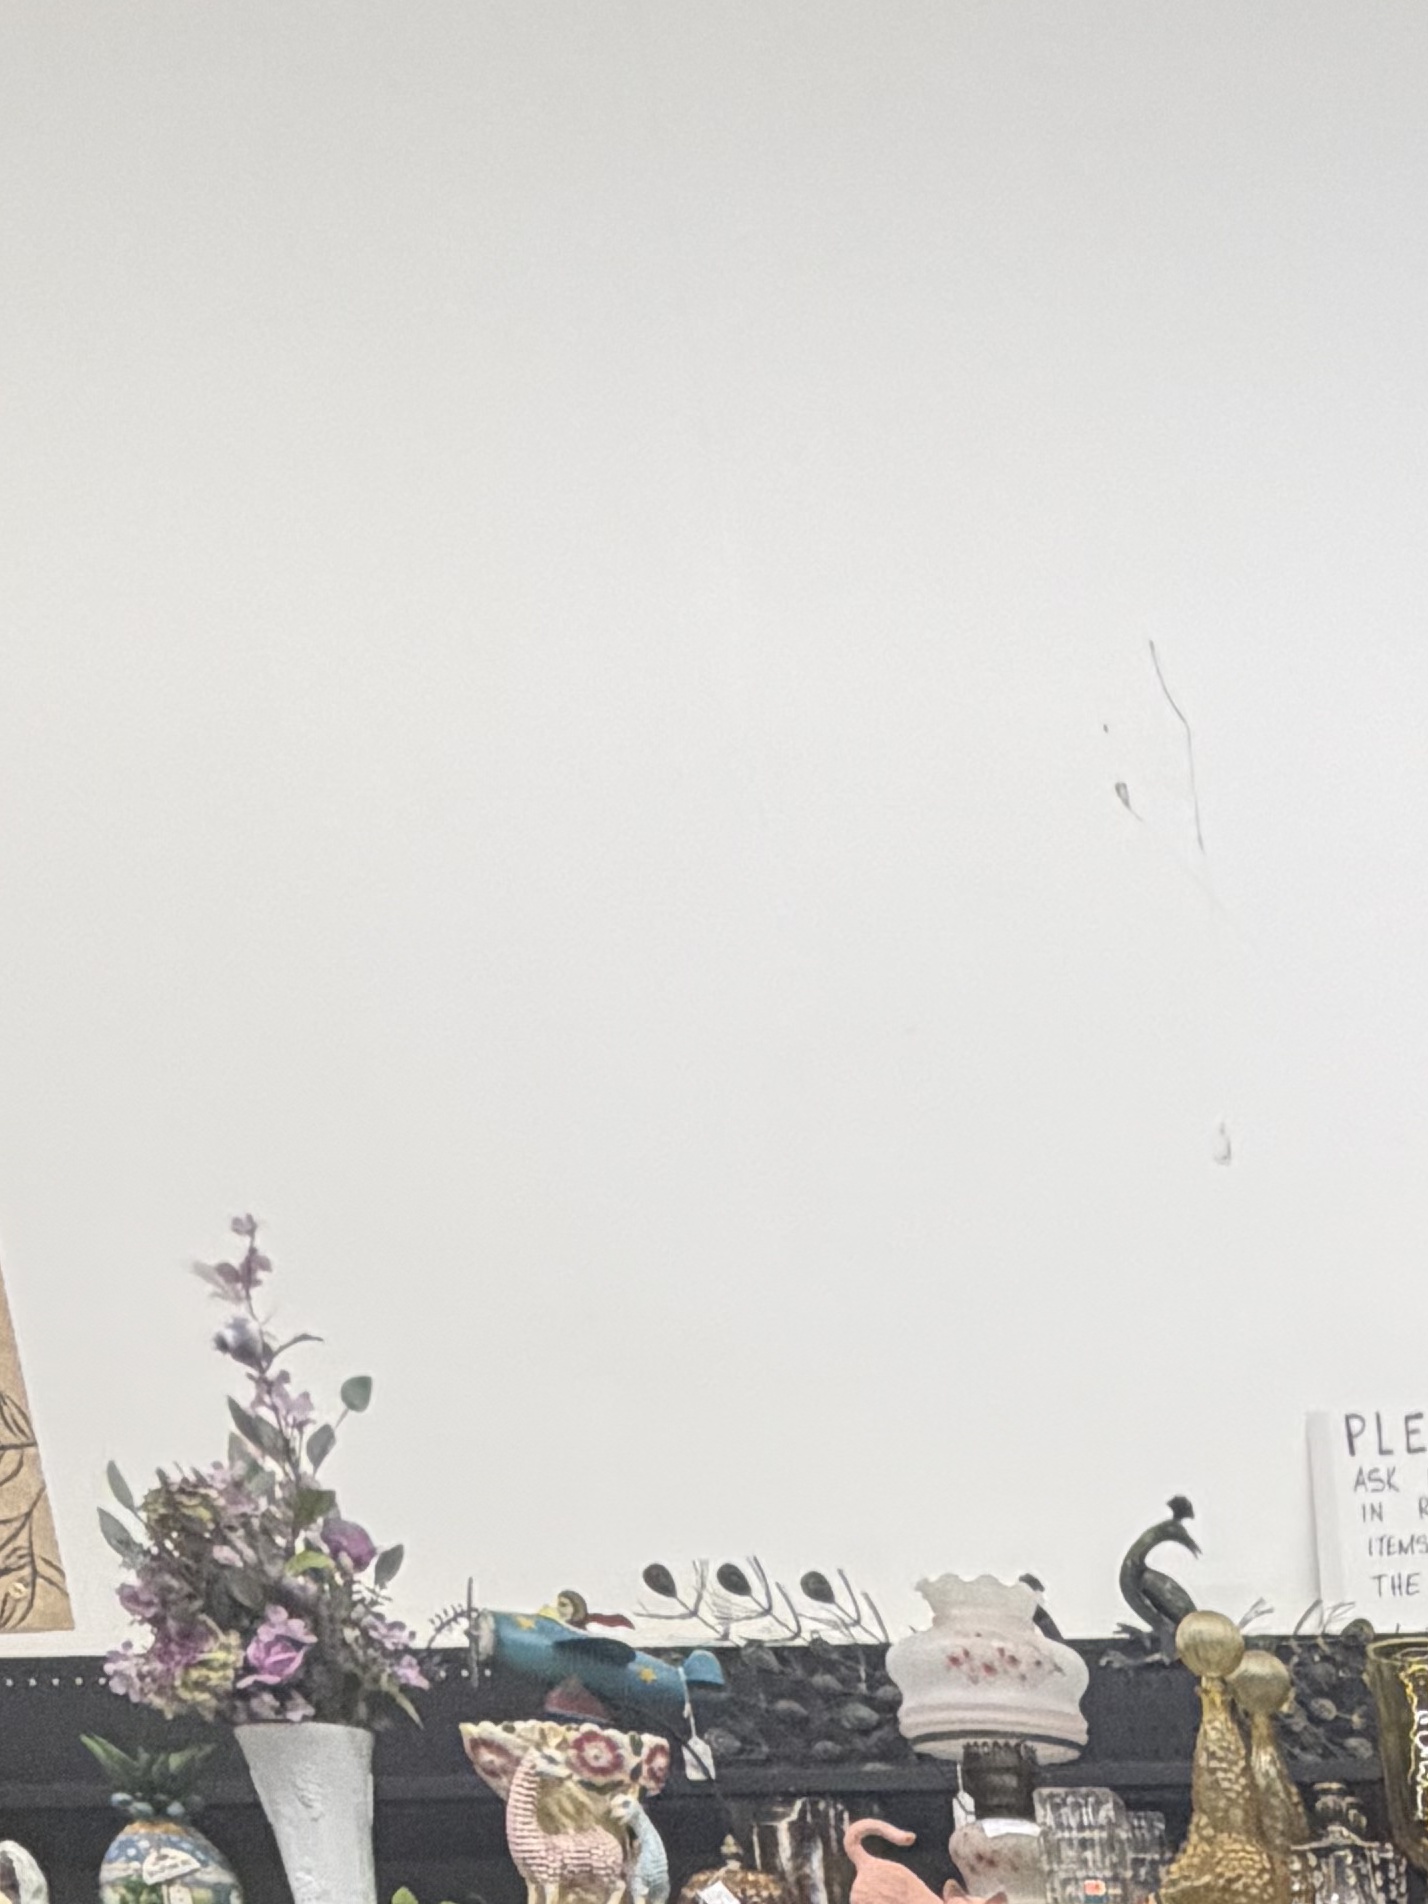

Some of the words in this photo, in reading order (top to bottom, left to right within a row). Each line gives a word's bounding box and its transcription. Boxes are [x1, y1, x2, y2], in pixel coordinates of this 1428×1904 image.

[1354, 1466, 1400, 1493] ASK
[1362, 1502, 1383, 1523] IN
[1370, 1572, 1420, 1597] THE
